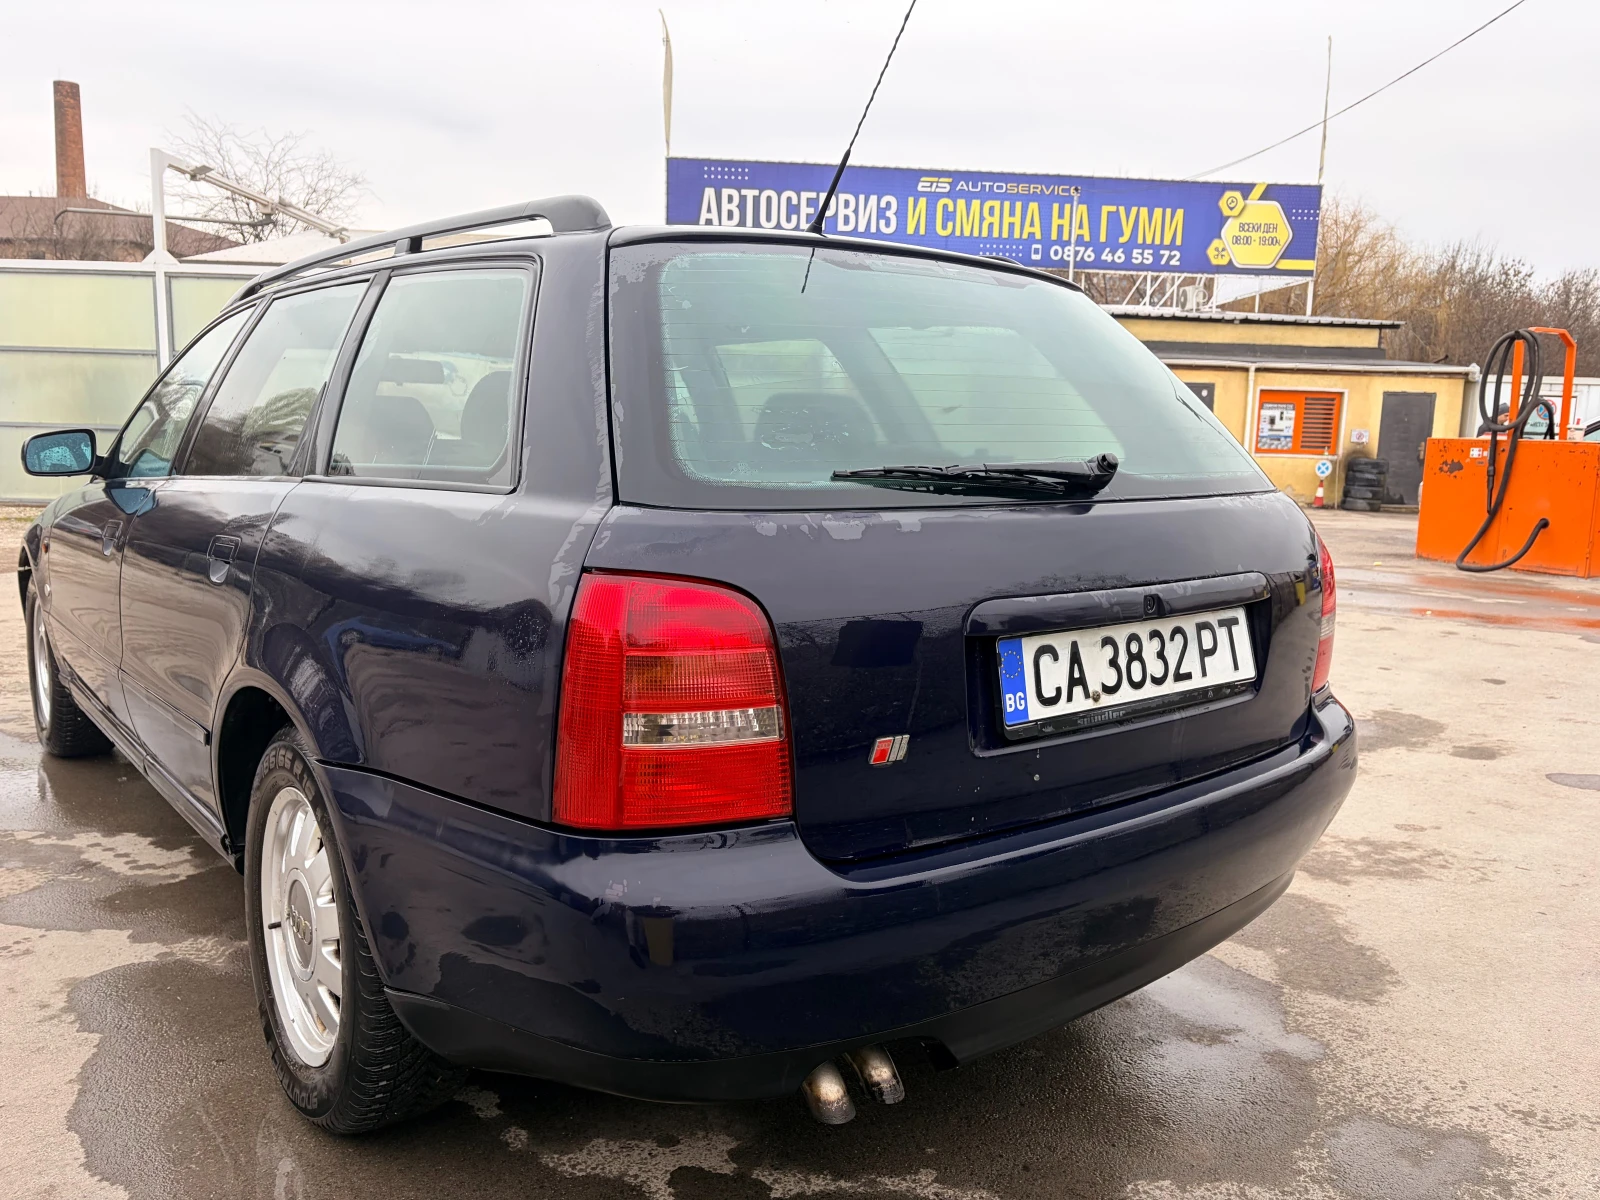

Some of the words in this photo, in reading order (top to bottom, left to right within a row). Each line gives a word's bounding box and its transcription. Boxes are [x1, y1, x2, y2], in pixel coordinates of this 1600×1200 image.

[956, 181, 1081, 196] AUTOSERVICE
[699, 186, 898, 234] АВТОСЕРВИЗ
[906, 197, 927, 235] И
[936, 198, 1041, 240] СМЯНА
[1051, 203, 1091, 242] НА
[1099, 206, 1185, 246] ГУМИ
[1238, 222, 1262, 233] ВСЕКИ
[1262, 223, 1278, 234] ДЕН
[1231, 235, 1252, 246] 08:00
[1050, 245, 1096, 263] 0876
[1101, 247, 1126, 263] 46
[1131, 249, 1154, 264] 55
[1159, 250, 1181, 266] 72
[1033, 640, 1091, 707] CA
[1099, 626, 1192, 695] 3832
[1195, 616, 1241, 678] PT
[1005, 691, 1026, 713] BG
